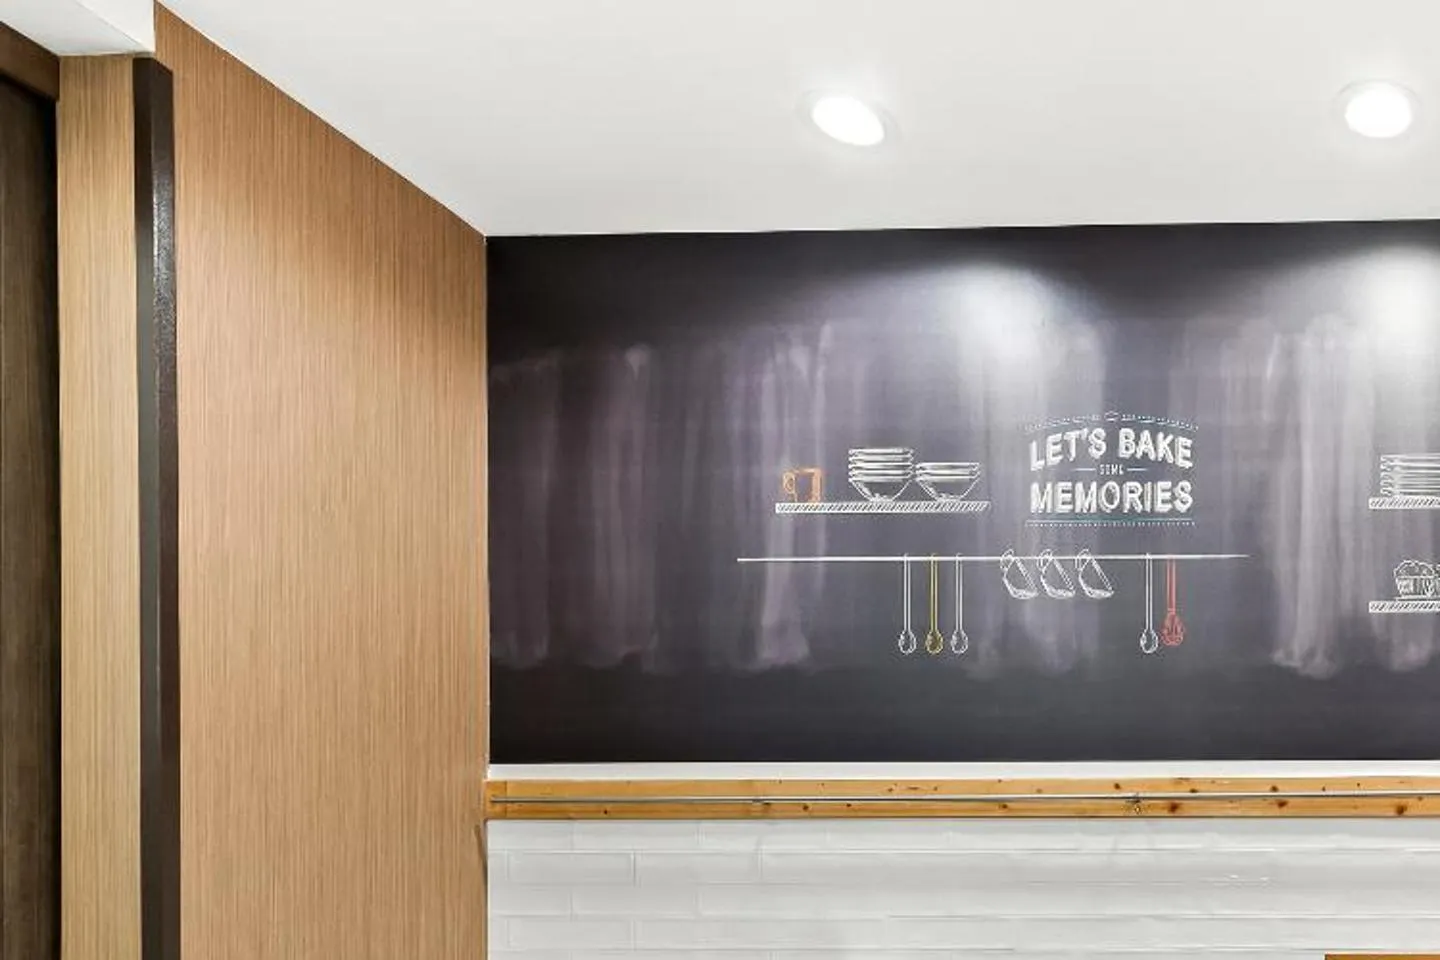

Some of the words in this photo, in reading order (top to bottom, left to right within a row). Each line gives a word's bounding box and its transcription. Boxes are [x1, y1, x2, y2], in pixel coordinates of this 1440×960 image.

[1030, 428, 1107, 471] LET'S
[1118, 428, 1193, 469] BAKE
[1030, 480, 1194, 513] MEMORIES
